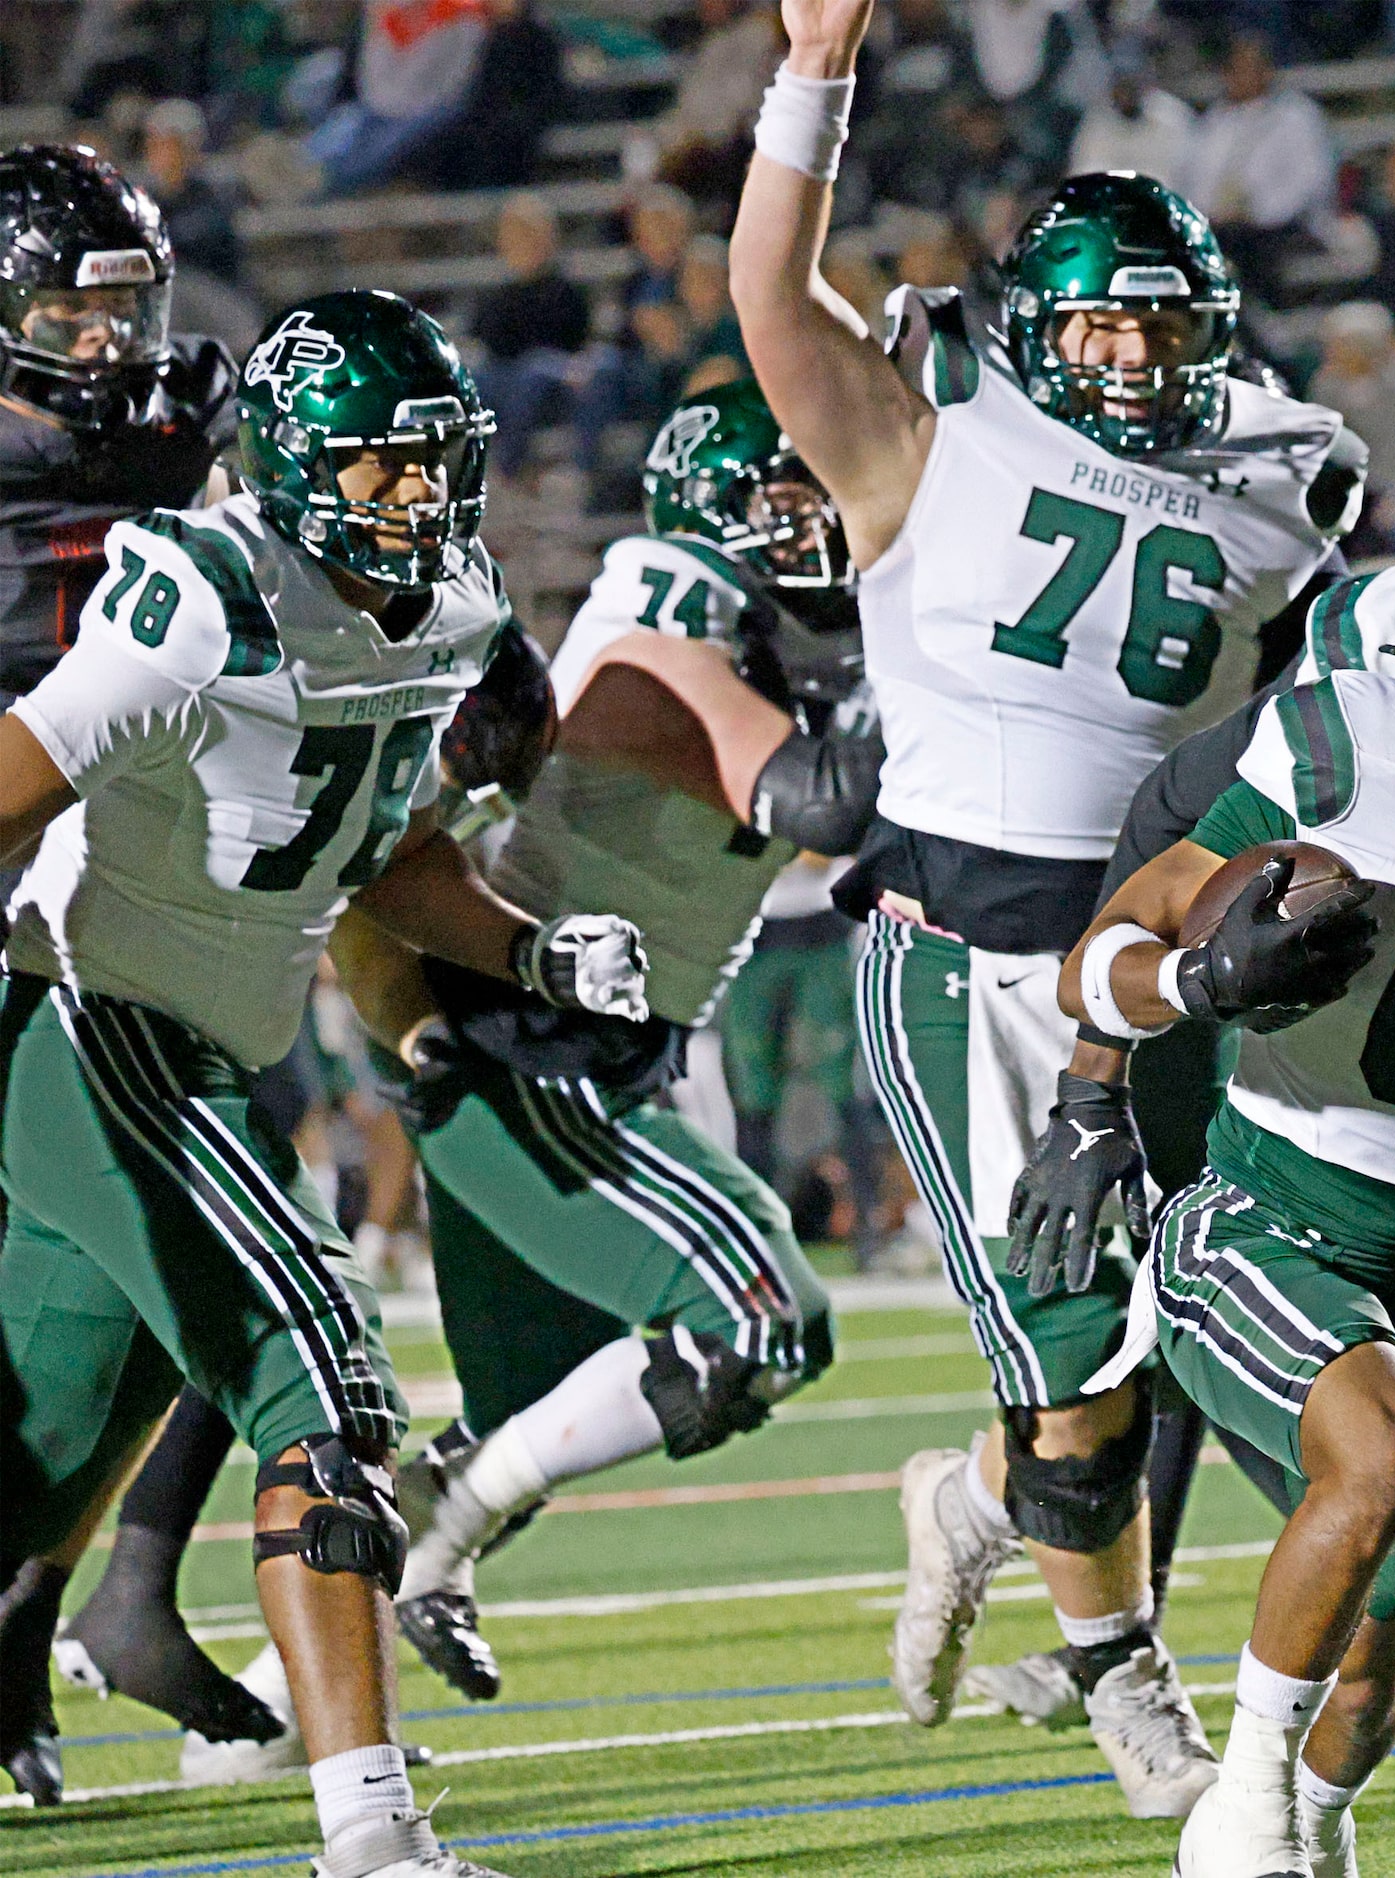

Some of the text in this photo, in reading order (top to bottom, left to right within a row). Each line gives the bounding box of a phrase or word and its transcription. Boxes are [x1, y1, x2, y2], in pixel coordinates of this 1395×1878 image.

[1070, 462, 1201, 520] PROSPER
[101, 543, 181, 649] 78
[636, 565, 712, 639] 74
[990, 485, 1228, 708] 76
[341, 686, 425, 722] PROSPER
